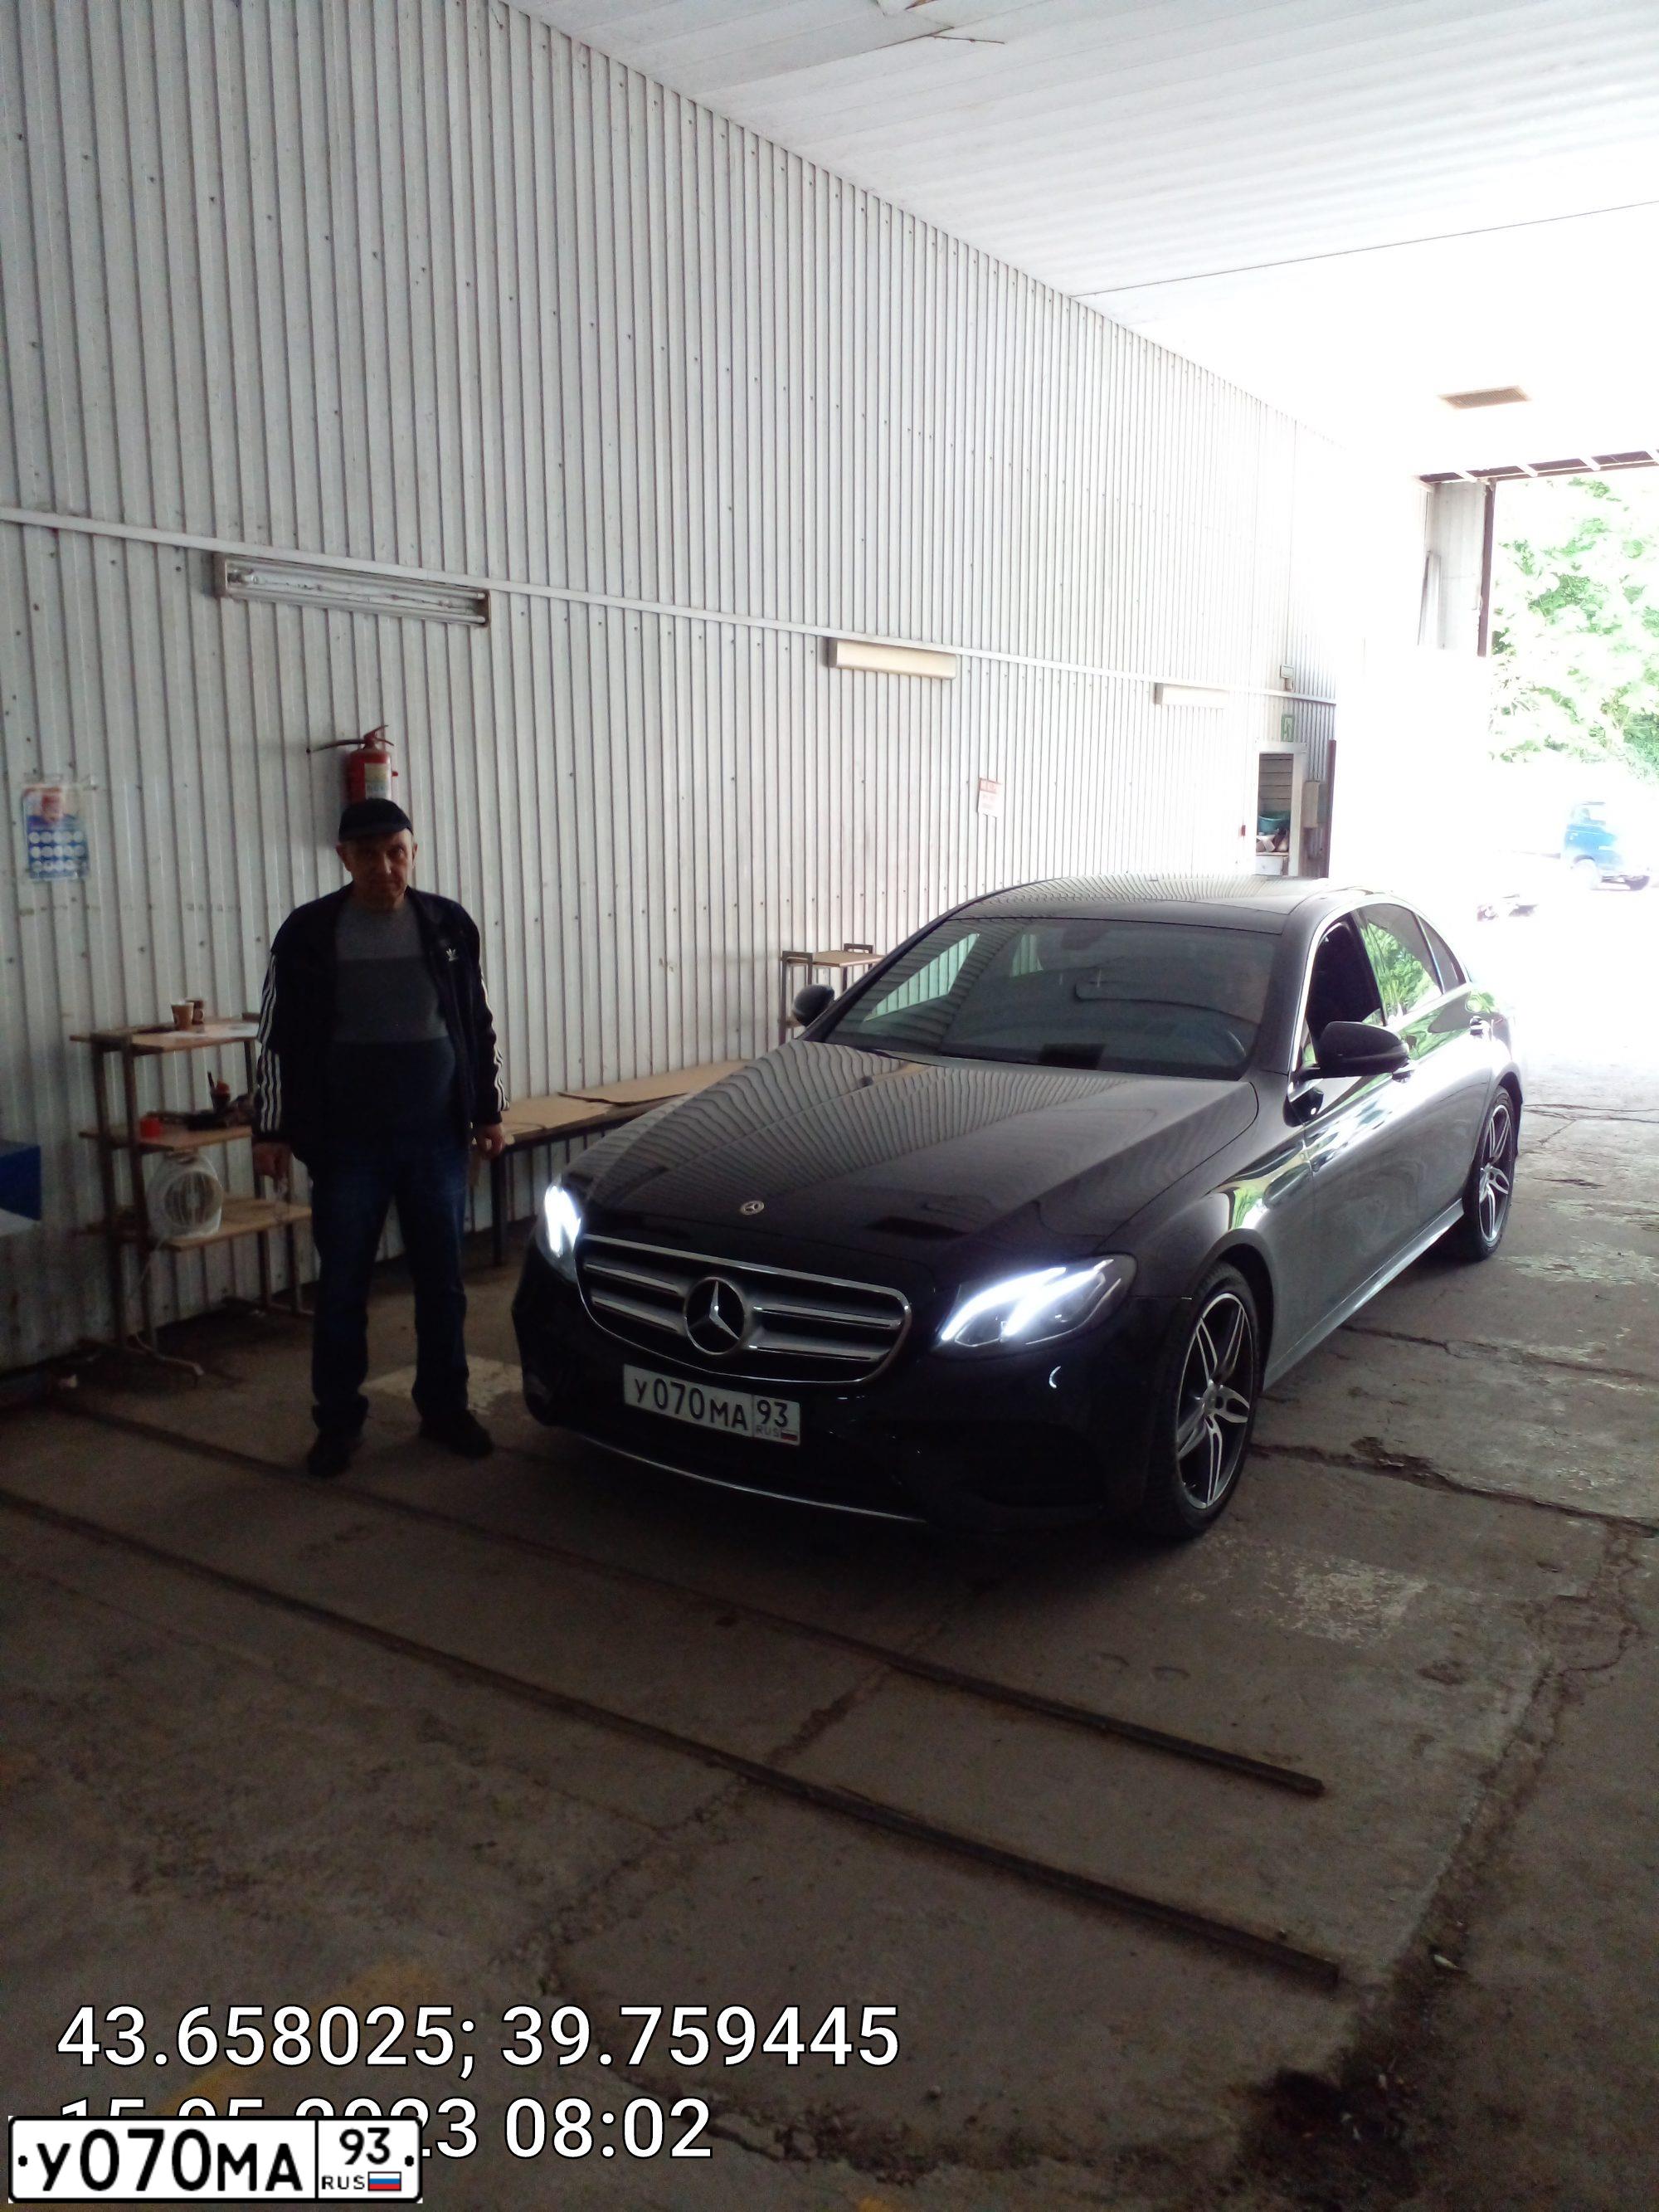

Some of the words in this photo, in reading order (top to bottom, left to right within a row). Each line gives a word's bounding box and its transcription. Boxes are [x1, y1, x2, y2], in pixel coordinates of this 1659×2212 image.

[634, 1378, 748, 1430] У070МА
[757, 1400, 788, 1427] 93
[756, 1425, 779, 1437] RUS
